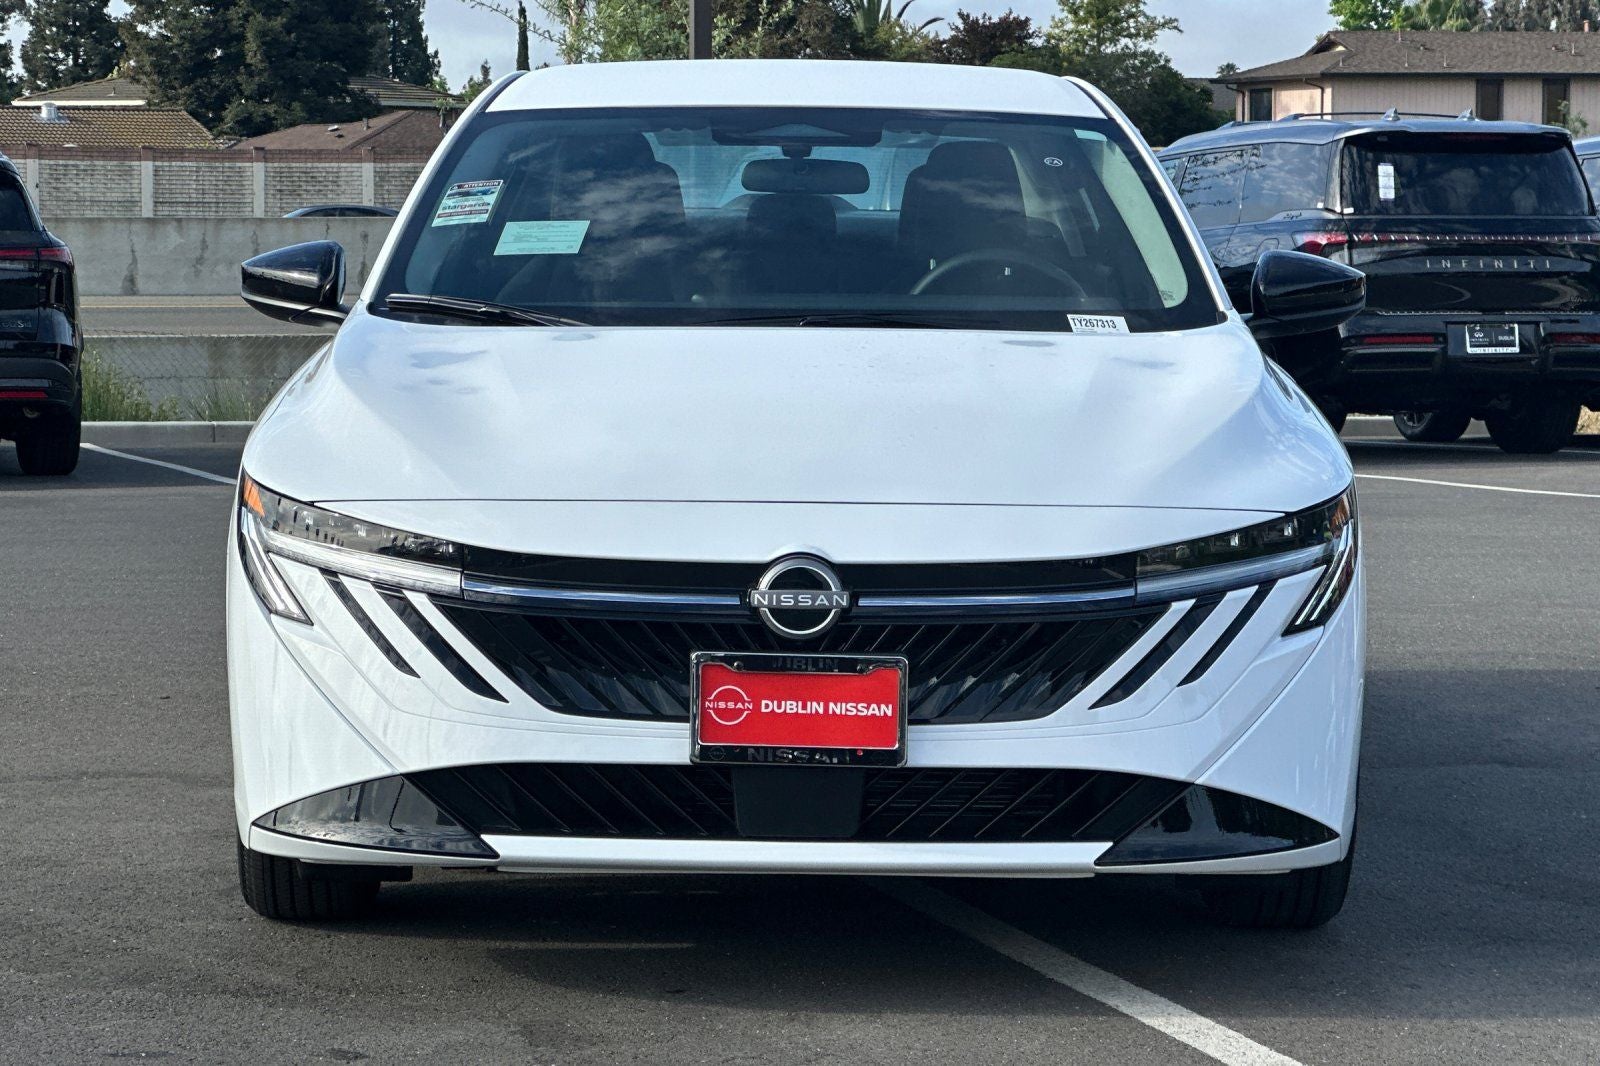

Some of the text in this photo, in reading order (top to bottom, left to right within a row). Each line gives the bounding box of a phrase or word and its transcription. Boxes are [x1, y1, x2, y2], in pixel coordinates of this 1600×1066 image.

[1426, 258, 1550, 269] INFINITI
[1070, 317, 1117, 329] TY267313
[754, 593, 847, 606] NISSAN
[705, 701, 753, 710] NISSAN
[760, 699, 893, 717] DUBLIN NISSAN
